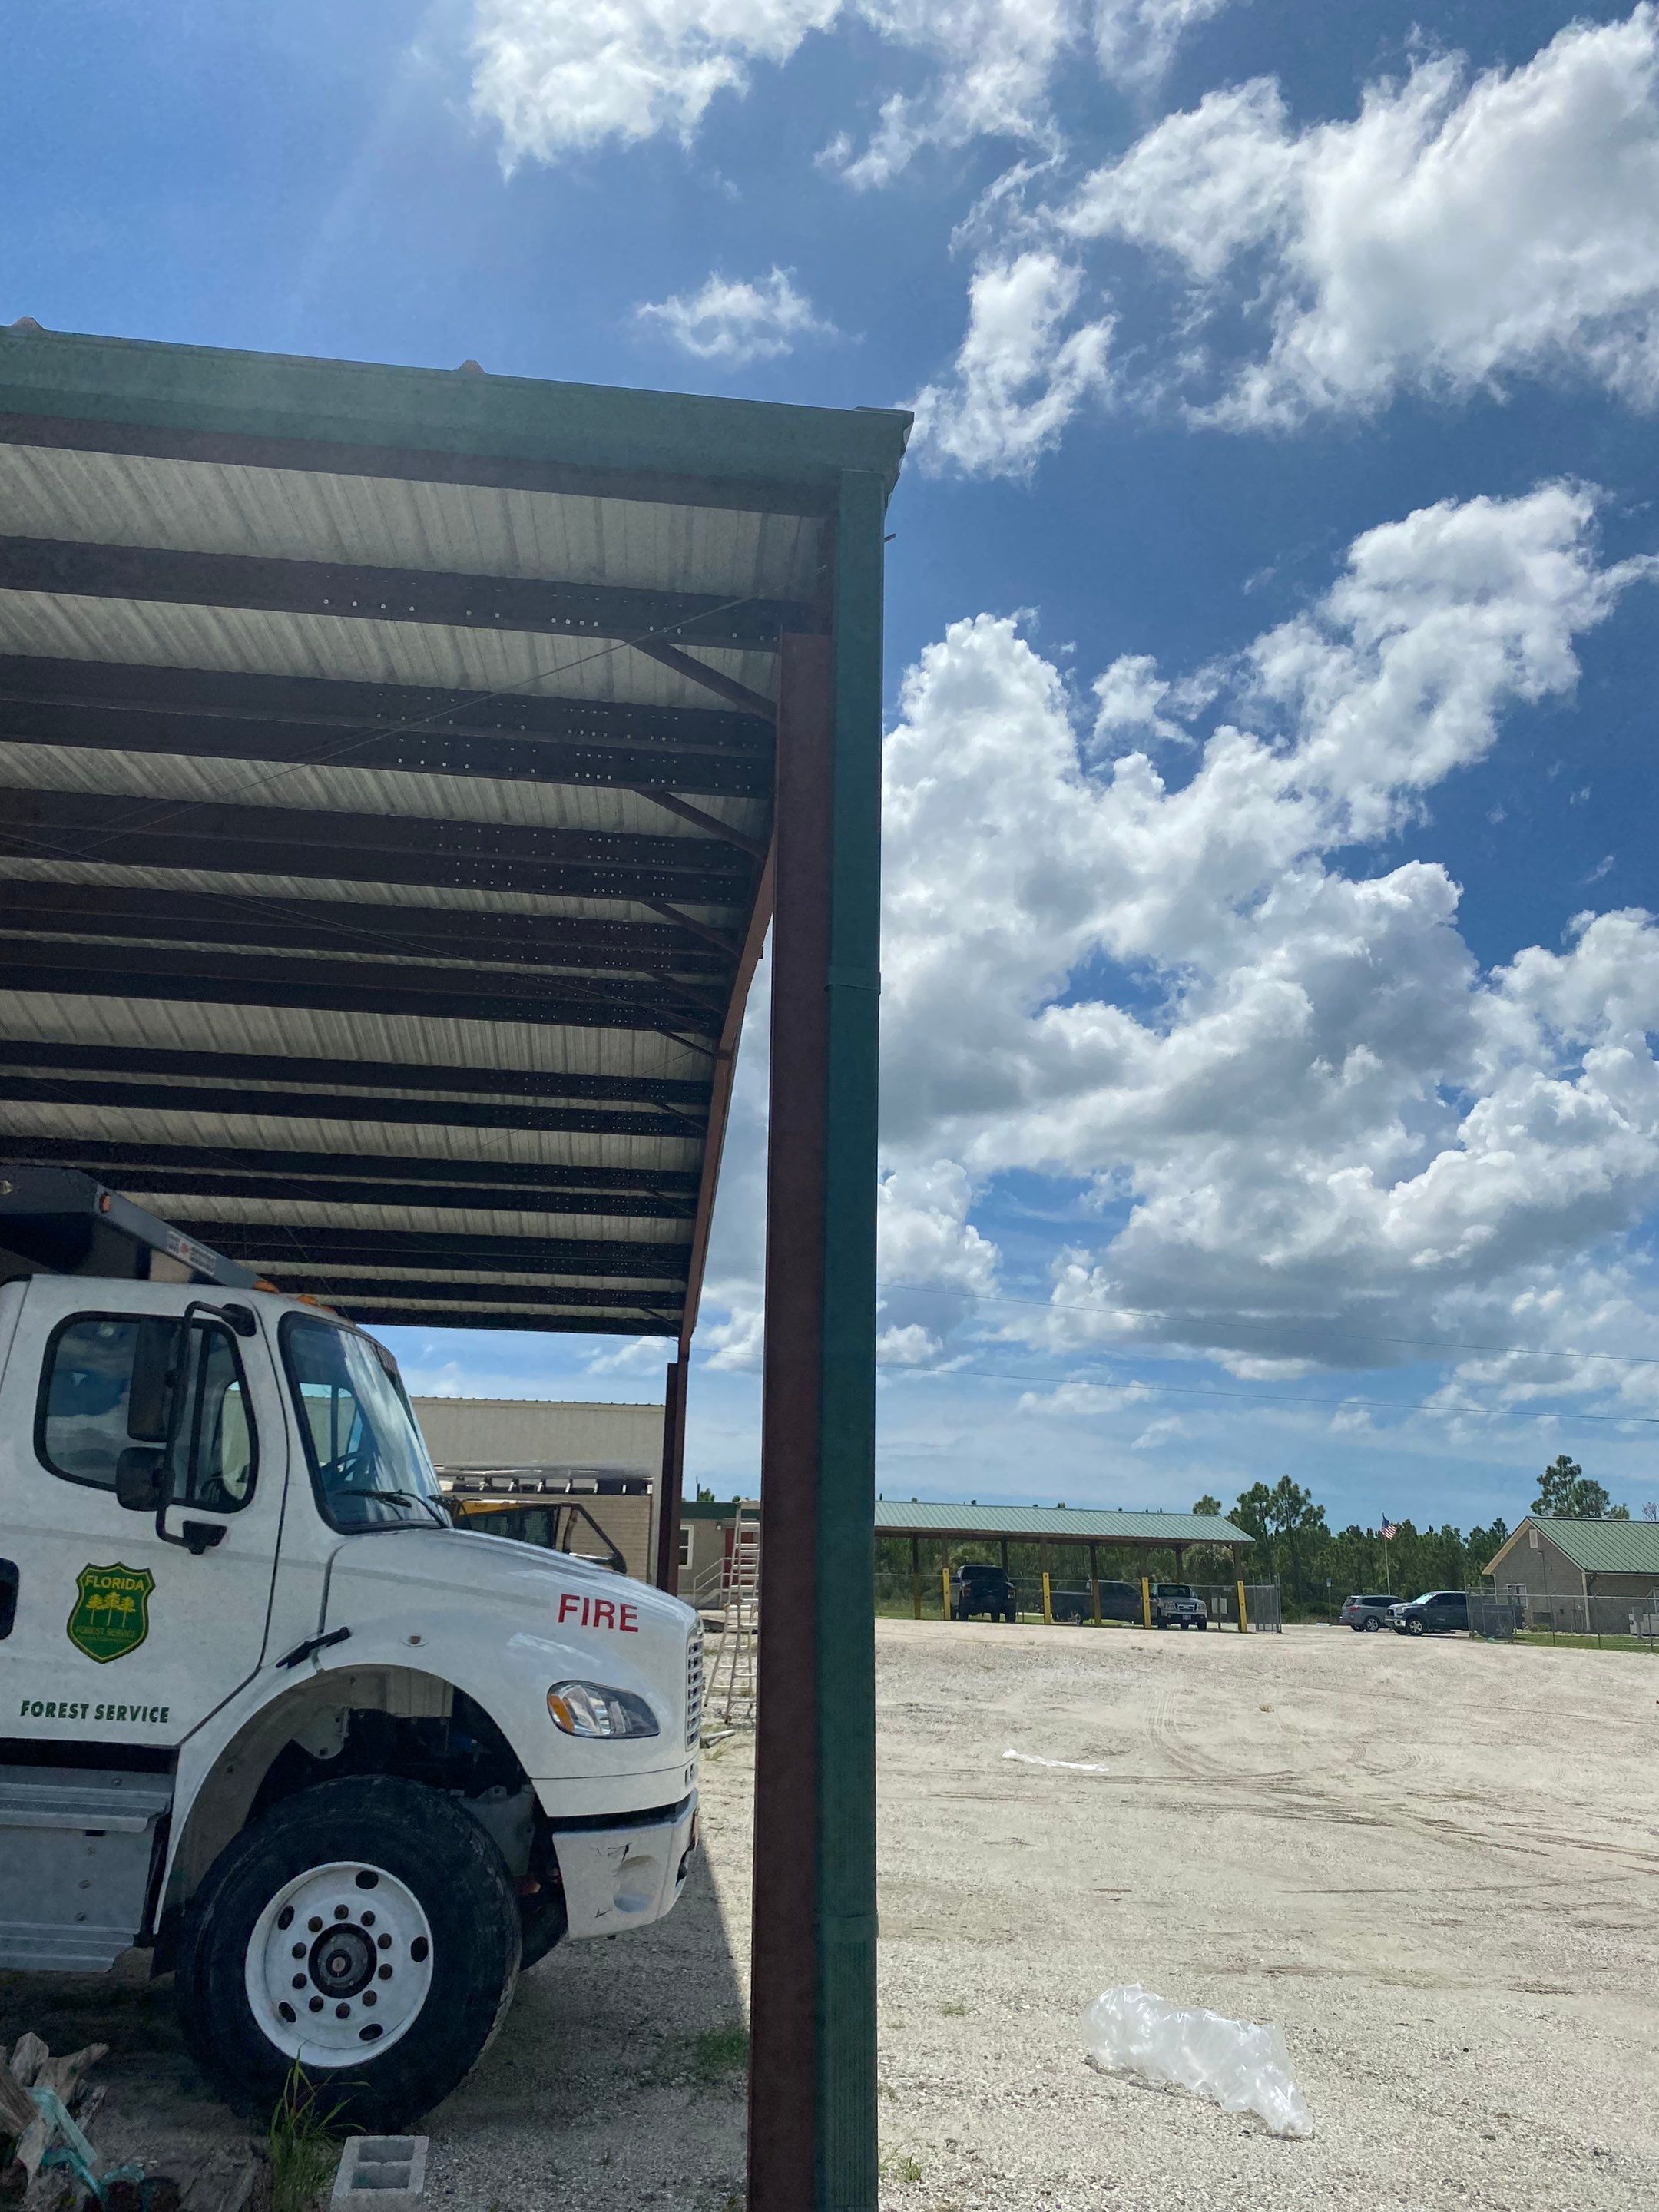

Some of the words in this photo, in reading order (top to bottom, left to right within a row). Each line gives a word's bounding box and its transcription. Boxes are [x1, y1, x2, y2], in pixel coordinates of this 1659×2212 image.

[84, 1575, 144, 1591] FLORIDA
[558, 1593, 639, 1632] FIRE
[20, 1700, 89, 1719] FOREST
[94, 1704, 170, 1723] SERVICE
